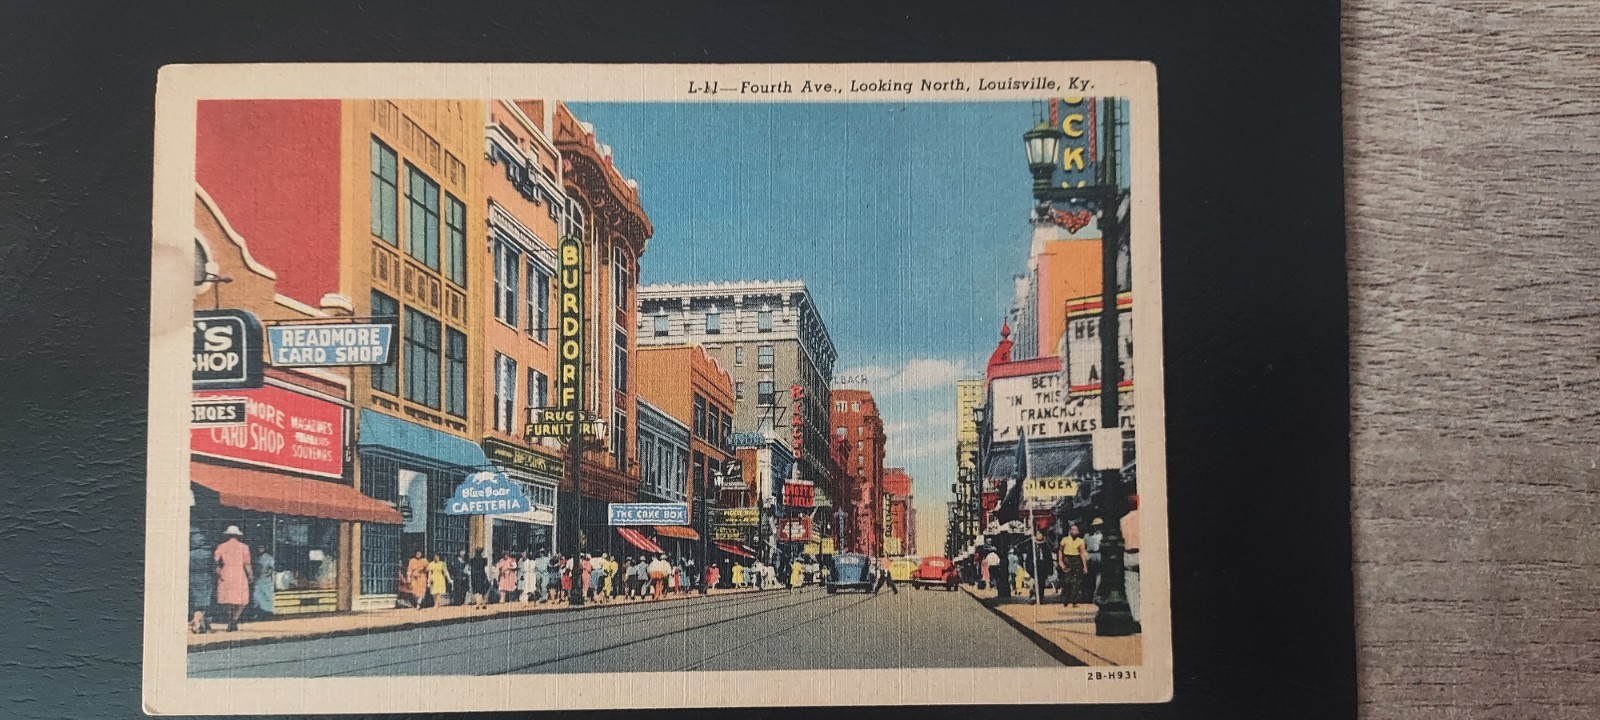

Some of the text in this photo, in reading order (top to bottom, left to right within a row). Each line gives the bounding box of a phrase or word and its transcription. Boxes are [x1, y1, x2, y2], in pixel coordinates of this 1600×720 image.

[800, 81, 843, 94] Ave.,
[850, 79, 914, 94] Looking
[920, 78, 970, 92] North,
[978, 77, 1062, 91] Louisville,
[1068, 77, 1096, 91] Ky.
[1061, 97, 1085, 189] CK
[562, 245, 579, 407] BURDORF
[282, 328, 381, 347] READMORE
[278, 345, 383, 363] CARD SHOP
[1057, 419, 1097, 434] TAKES
[249, 422, 285, 455] SHOP
[462, 487, 510, 498] Blue Boar
[452, 499, 520, 513] CAFETERIA
[616, 510, 683, 519] THE CAKE BOX
[1087, 670, 1137, 681] 2B-H931
